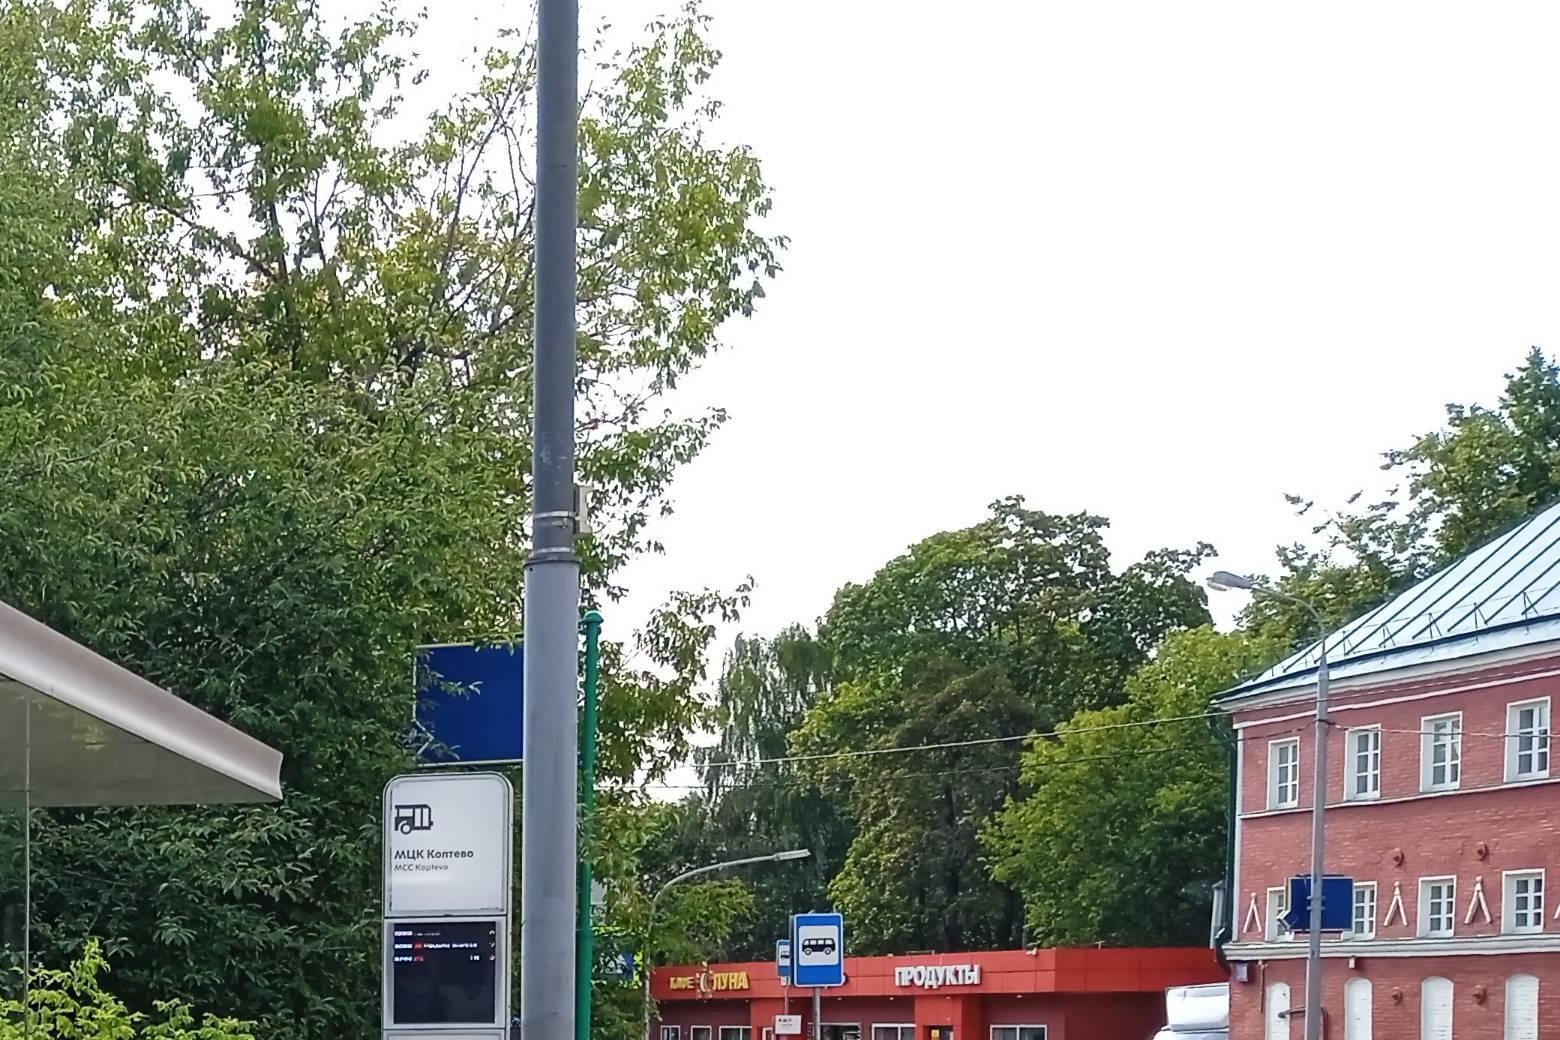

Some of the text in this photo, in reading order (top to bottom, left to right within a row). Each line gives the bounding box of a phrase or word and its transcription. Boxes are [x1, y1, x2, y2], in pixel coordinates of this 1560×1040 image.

[394, 849, 474, 861] МЦК Коптево
[712, 972, 749, 990] ЛУНА
[894, 964, 981, 990] ПРОДУКТЫ
